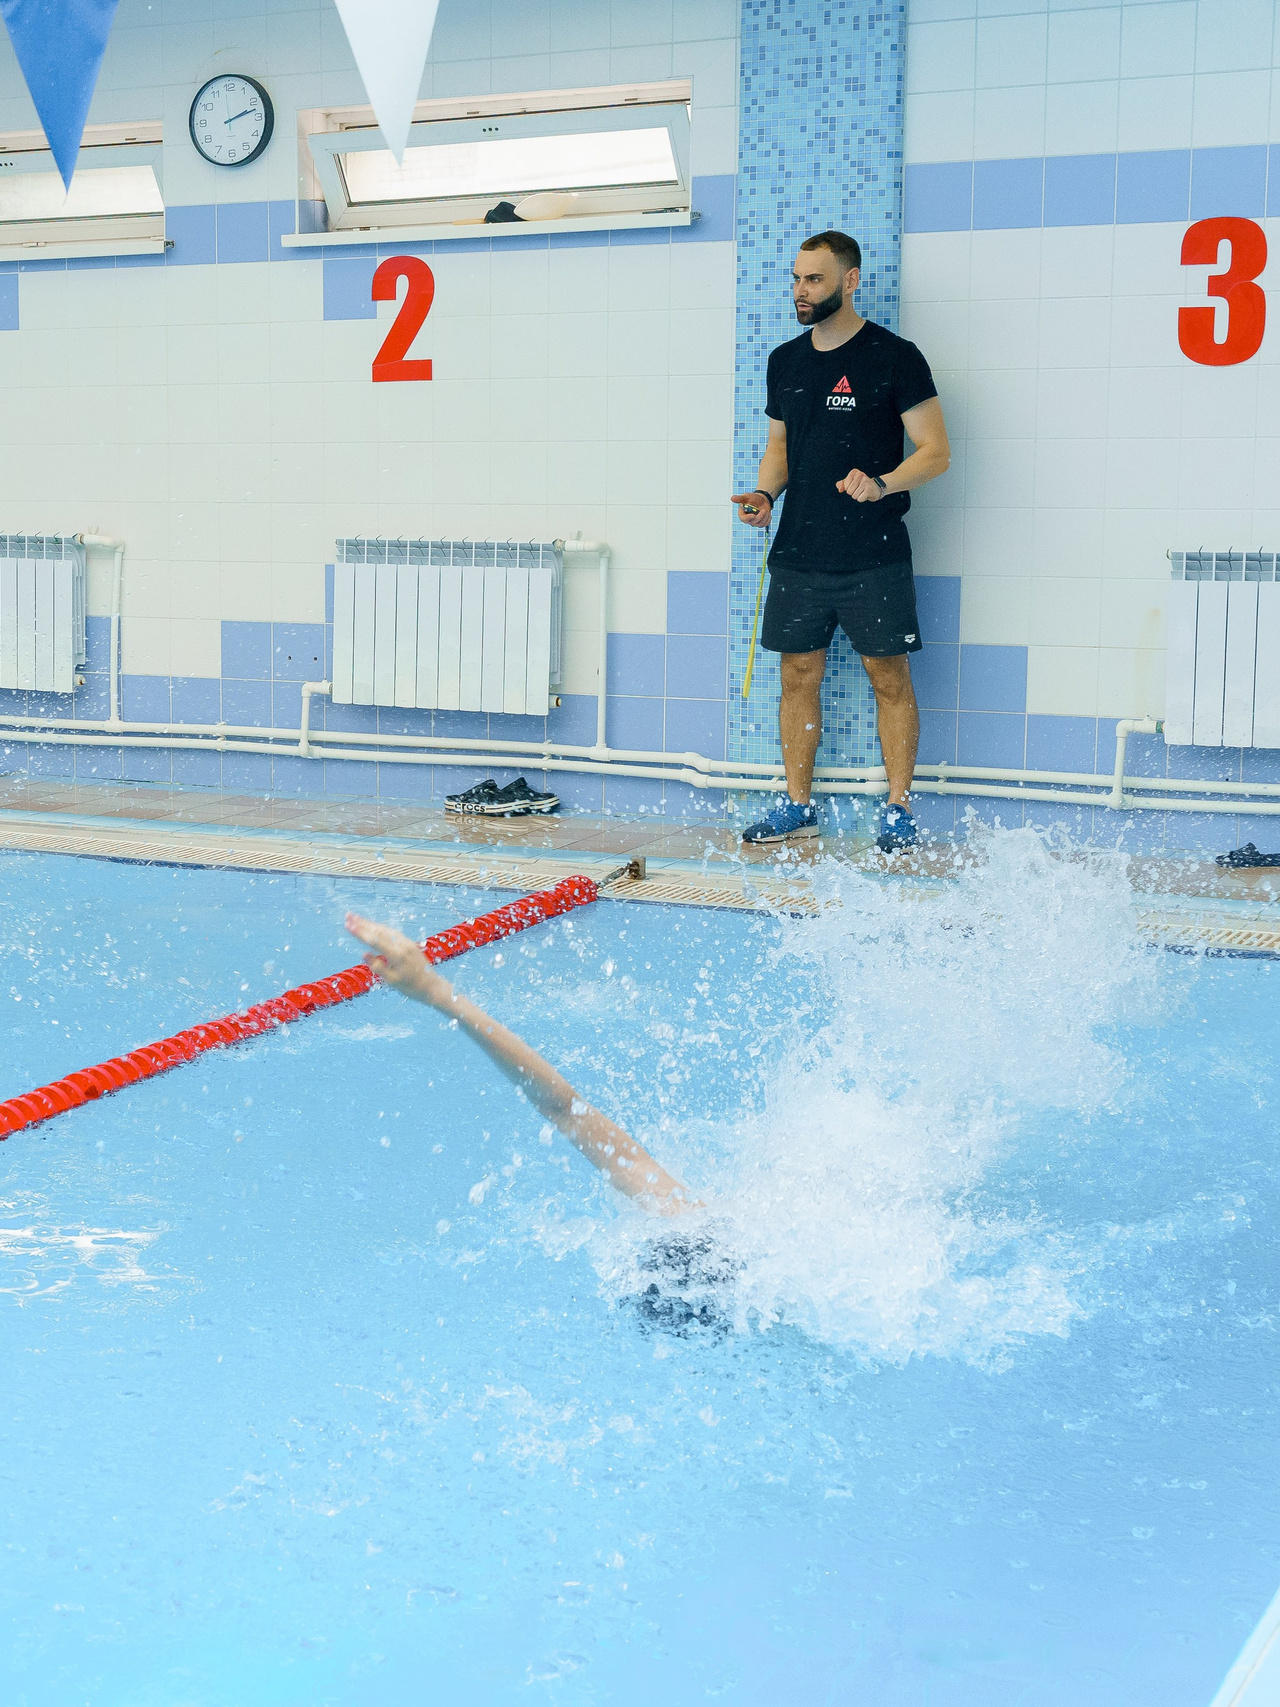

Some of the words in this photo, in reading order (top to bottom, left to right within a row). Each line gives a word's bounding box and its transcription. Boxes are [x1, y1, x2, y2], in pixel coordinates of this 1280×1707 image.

[223, 83, 235, 92] 12
[241, 87, 246, 95] 1
[211, 90, 220, 98] 11
[250, 97, 257, 106] 2
[202, 103, 213, 111] 10
[254, 113, 263, 121] 3
[200, 119, 207, 127] 9
[205, 135, 212, 143] 8
[215, 145, 222, 154] 7
[242, 142, 250, 151] 5
[228, 149, 236, 158] 6
[1178, 217, 1268, 366] 3
[372, 255, 435, 382] 2
[826, 396, 856, 407] ГОРА
[454, 802, 486, 813] crocs
